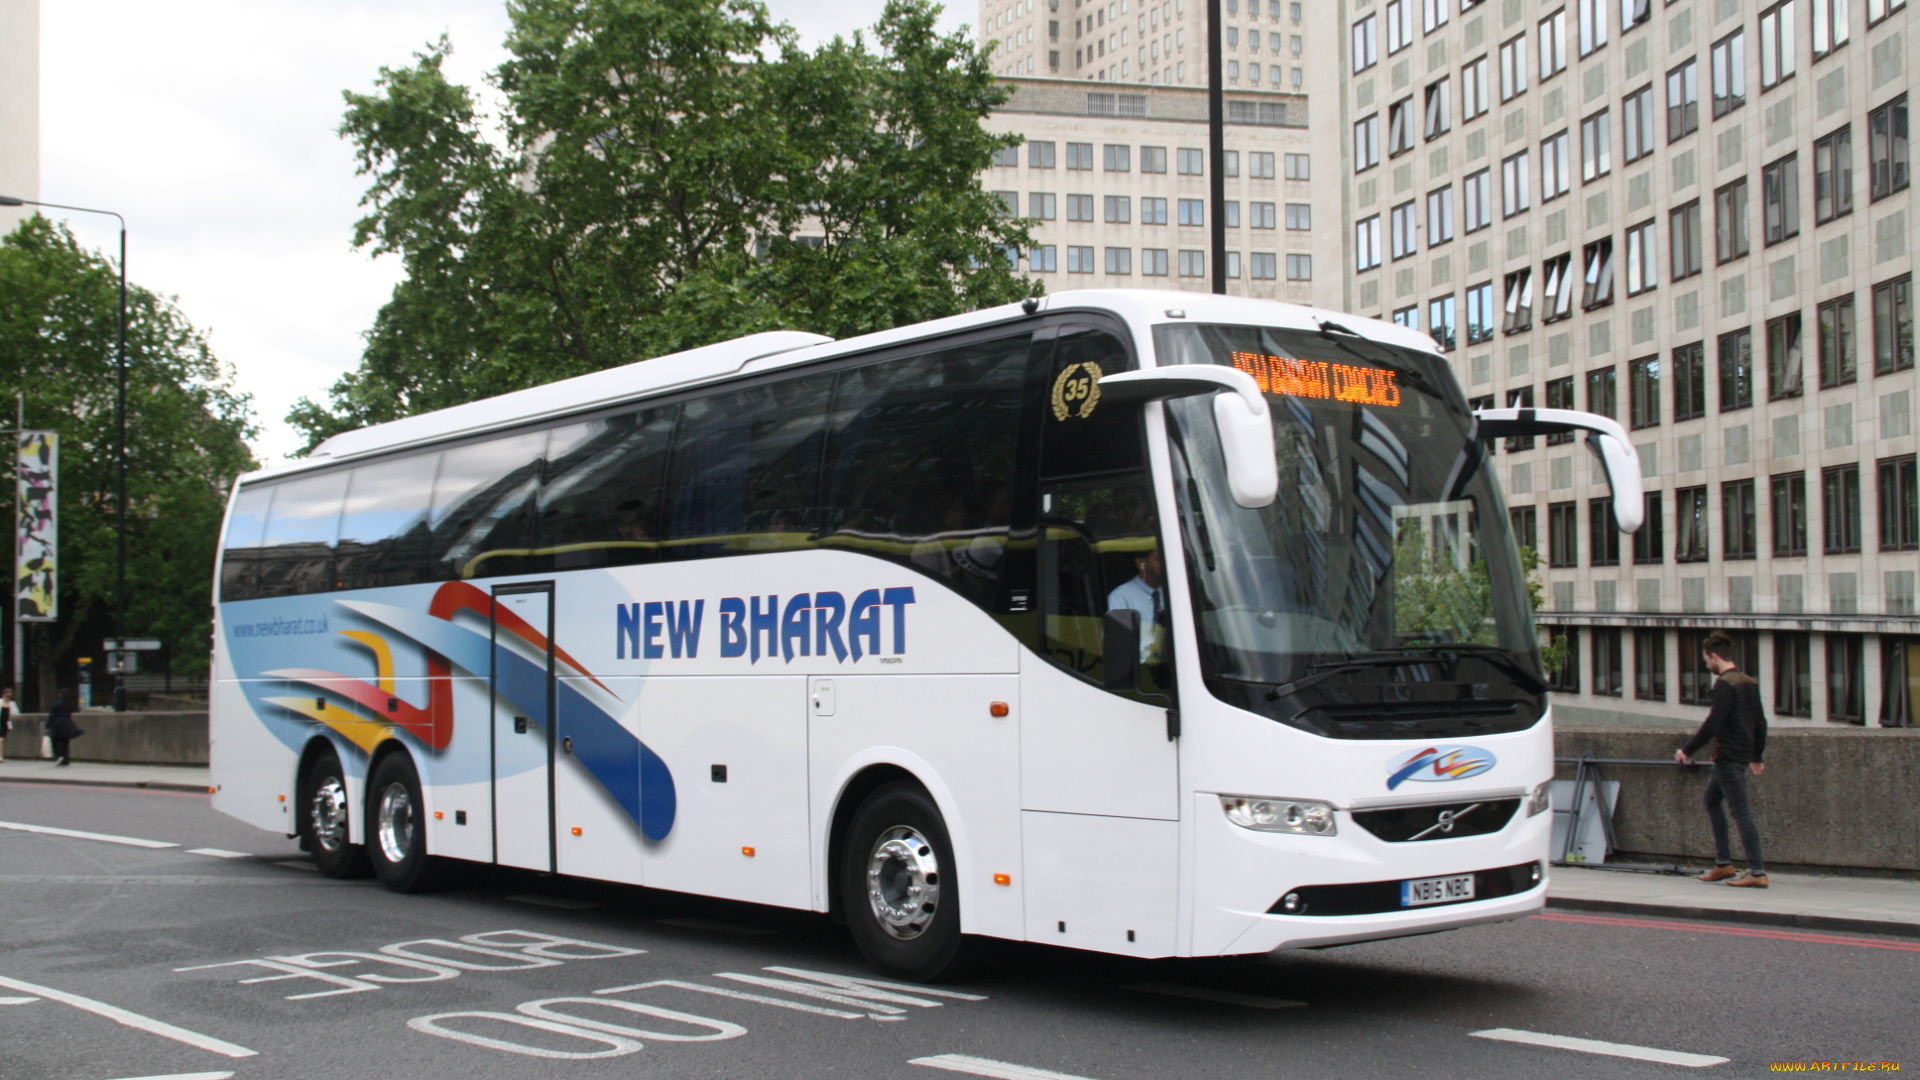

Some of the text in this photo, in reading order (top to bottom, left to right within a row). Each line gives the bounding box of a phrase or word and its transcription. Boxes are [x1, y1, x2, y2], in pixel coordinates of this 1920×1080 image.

[1064, 377, 1089, 401] 35
[1332, 363, 1401, 407] COACHES
[233, 613, 329, 638] www.newbharat.co.uk
[616, 586, 916, 666] NEW BHARAT
[1413, 878, 1470, 901] NB15 NBC
